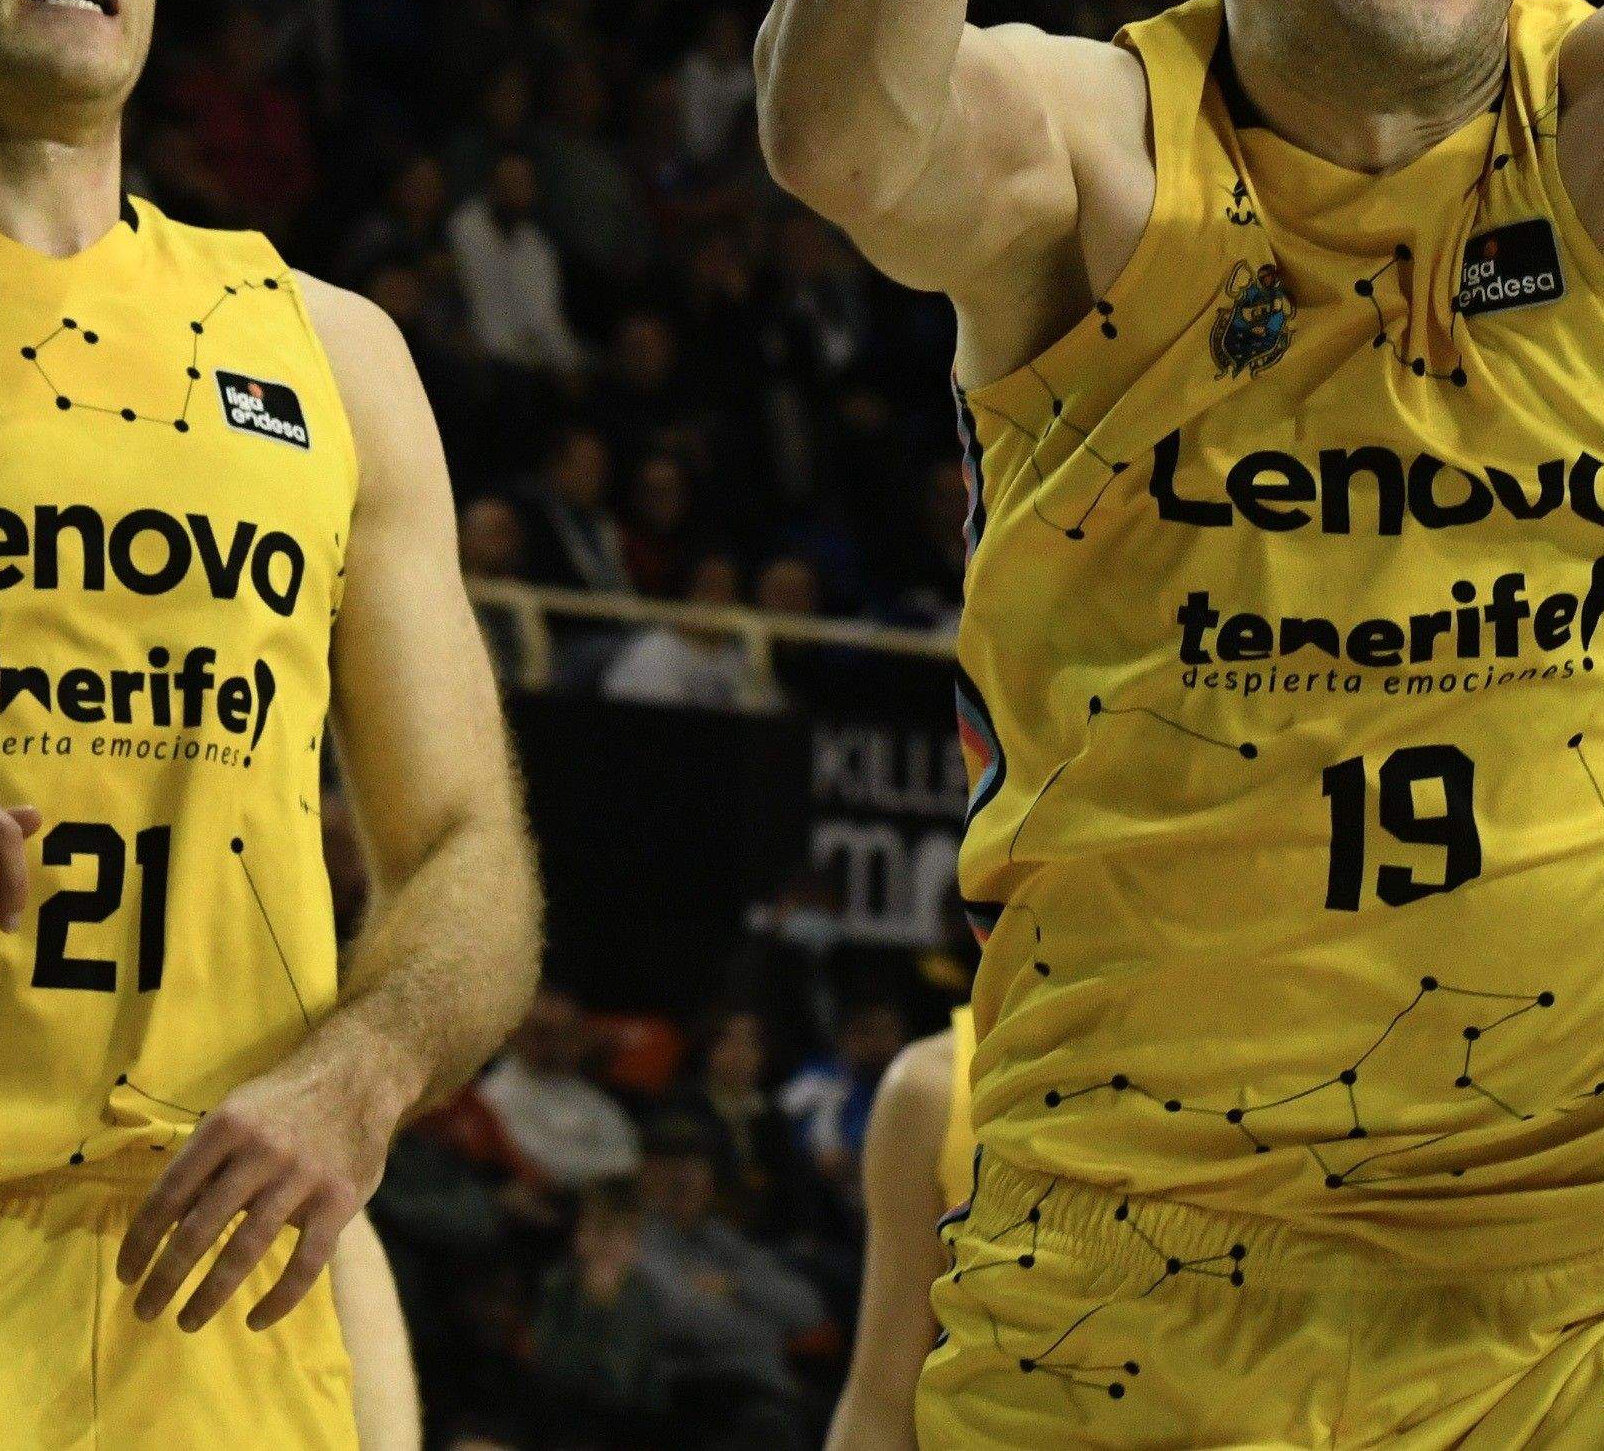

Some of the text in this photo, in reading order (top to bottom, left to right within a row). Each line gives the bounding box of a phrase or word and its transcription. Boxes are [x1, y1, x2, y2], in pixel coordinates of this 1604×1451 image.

[1458, 272, 1556, 309] endesa
[225, 386, 265, 412] liga
[231, 408, 308, 443] endesa
[1182, 659, 1575, 698] despierta emociones
[91, 733, 240, 767] emociones
[1321, 745, 1483, 912] 19
[30, 820, 172, 994] 21
